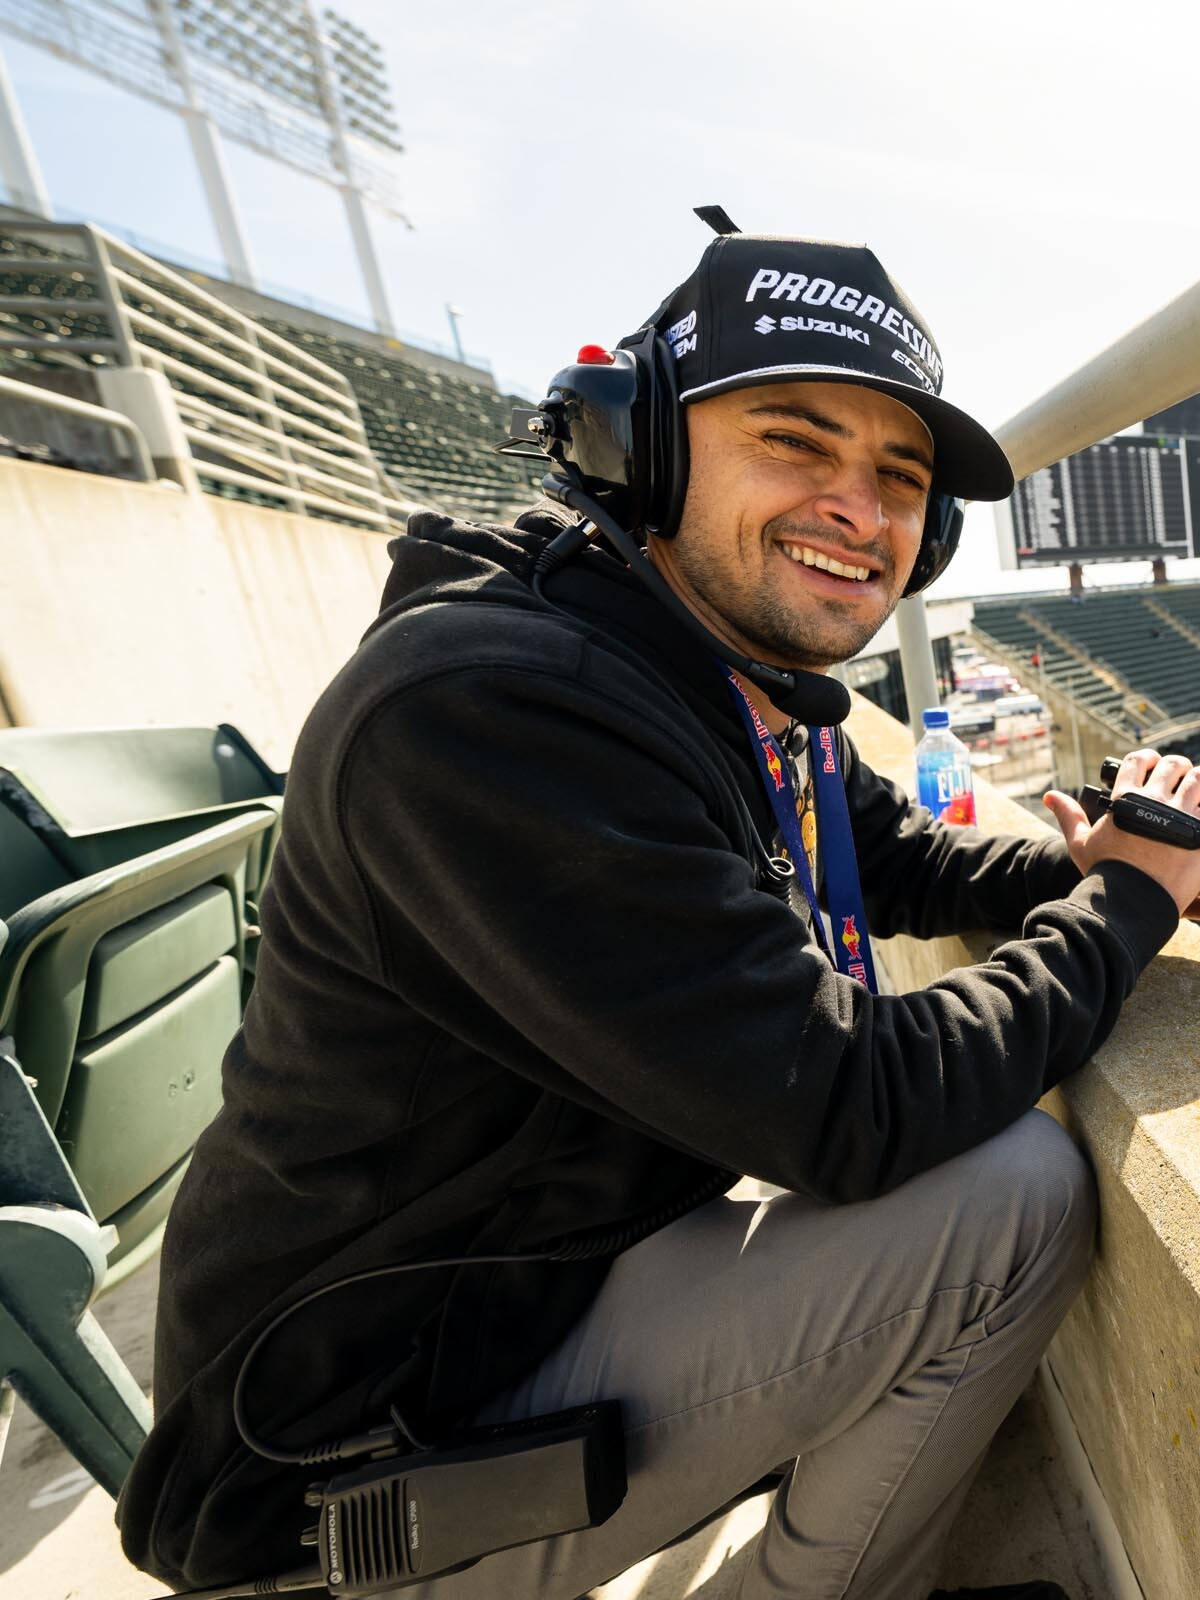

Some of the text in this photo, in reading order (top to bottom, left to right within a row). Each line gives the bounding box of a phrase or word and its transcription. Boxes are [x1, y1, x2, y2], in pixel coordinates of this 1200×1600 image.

[780, 316, 871, 346] SUZUKI
[821, 742, 836, 773] Red
[1136, 809, 1170, 826] SONY
[328, 1504, 338, 1569] MOTOROLA
